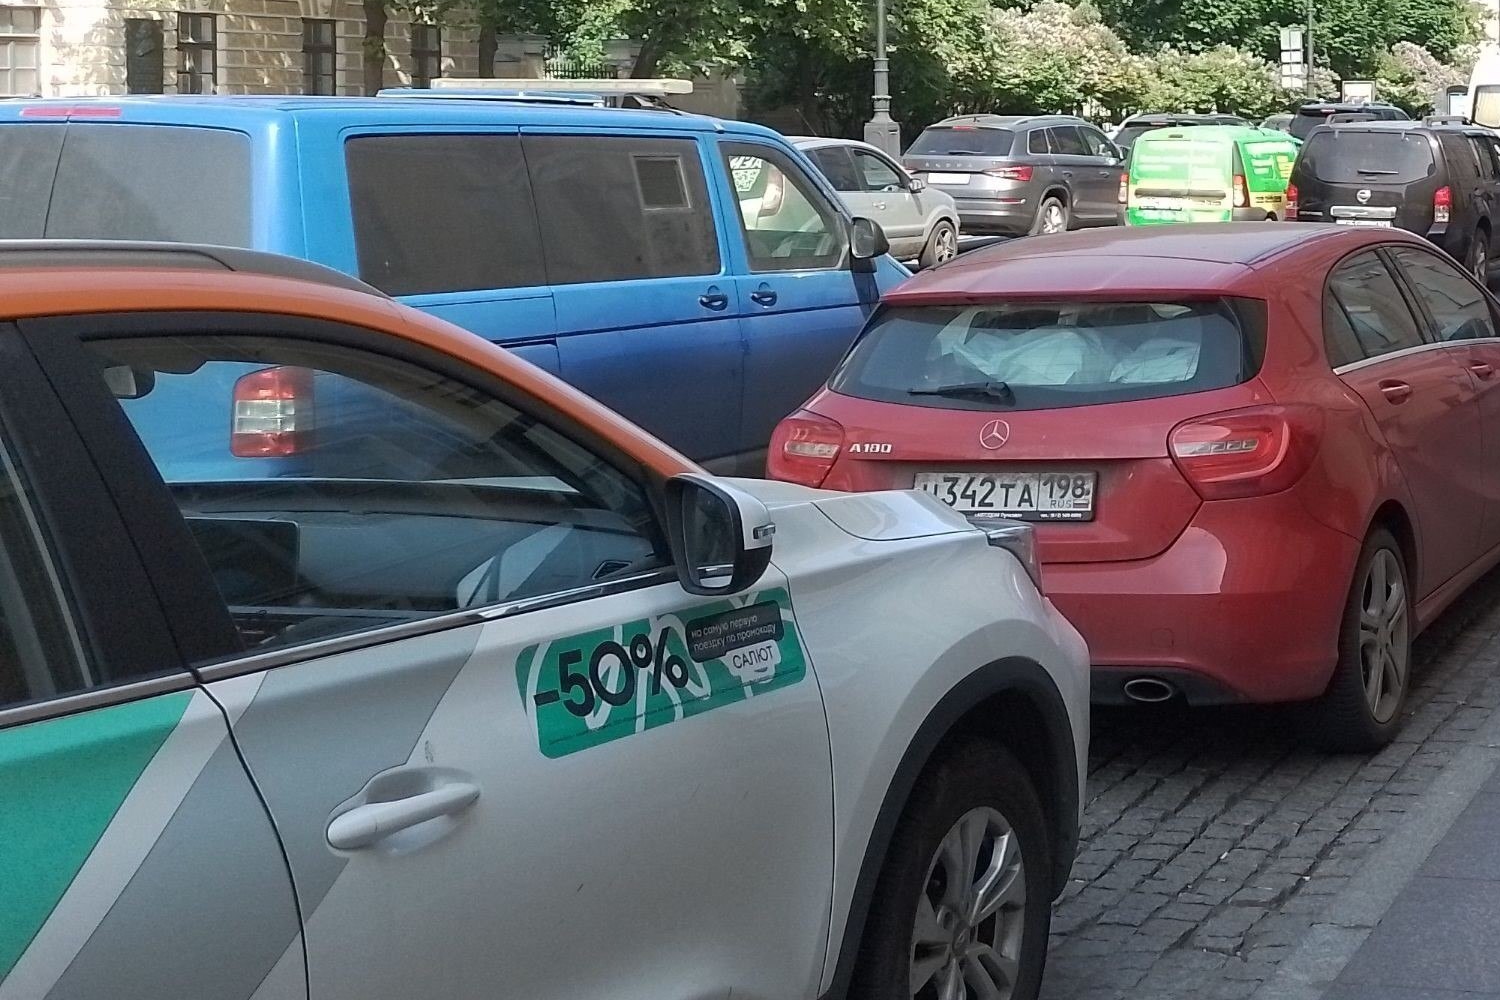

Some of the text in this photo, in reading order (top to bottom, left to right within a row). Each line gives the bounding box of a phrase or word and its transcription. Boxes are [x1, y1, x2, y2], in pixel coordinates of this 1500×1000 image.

[1041, 474, 1087, 499] 198
[1050, 499, 1072, 509] RUS
[691, 615, 758, 638] на самую первую
[693, 624, 776, 652] поездку по промокоду
[732, 645, 773, 669] САЛЮТ
[533, 625, 689, 717] -50%
